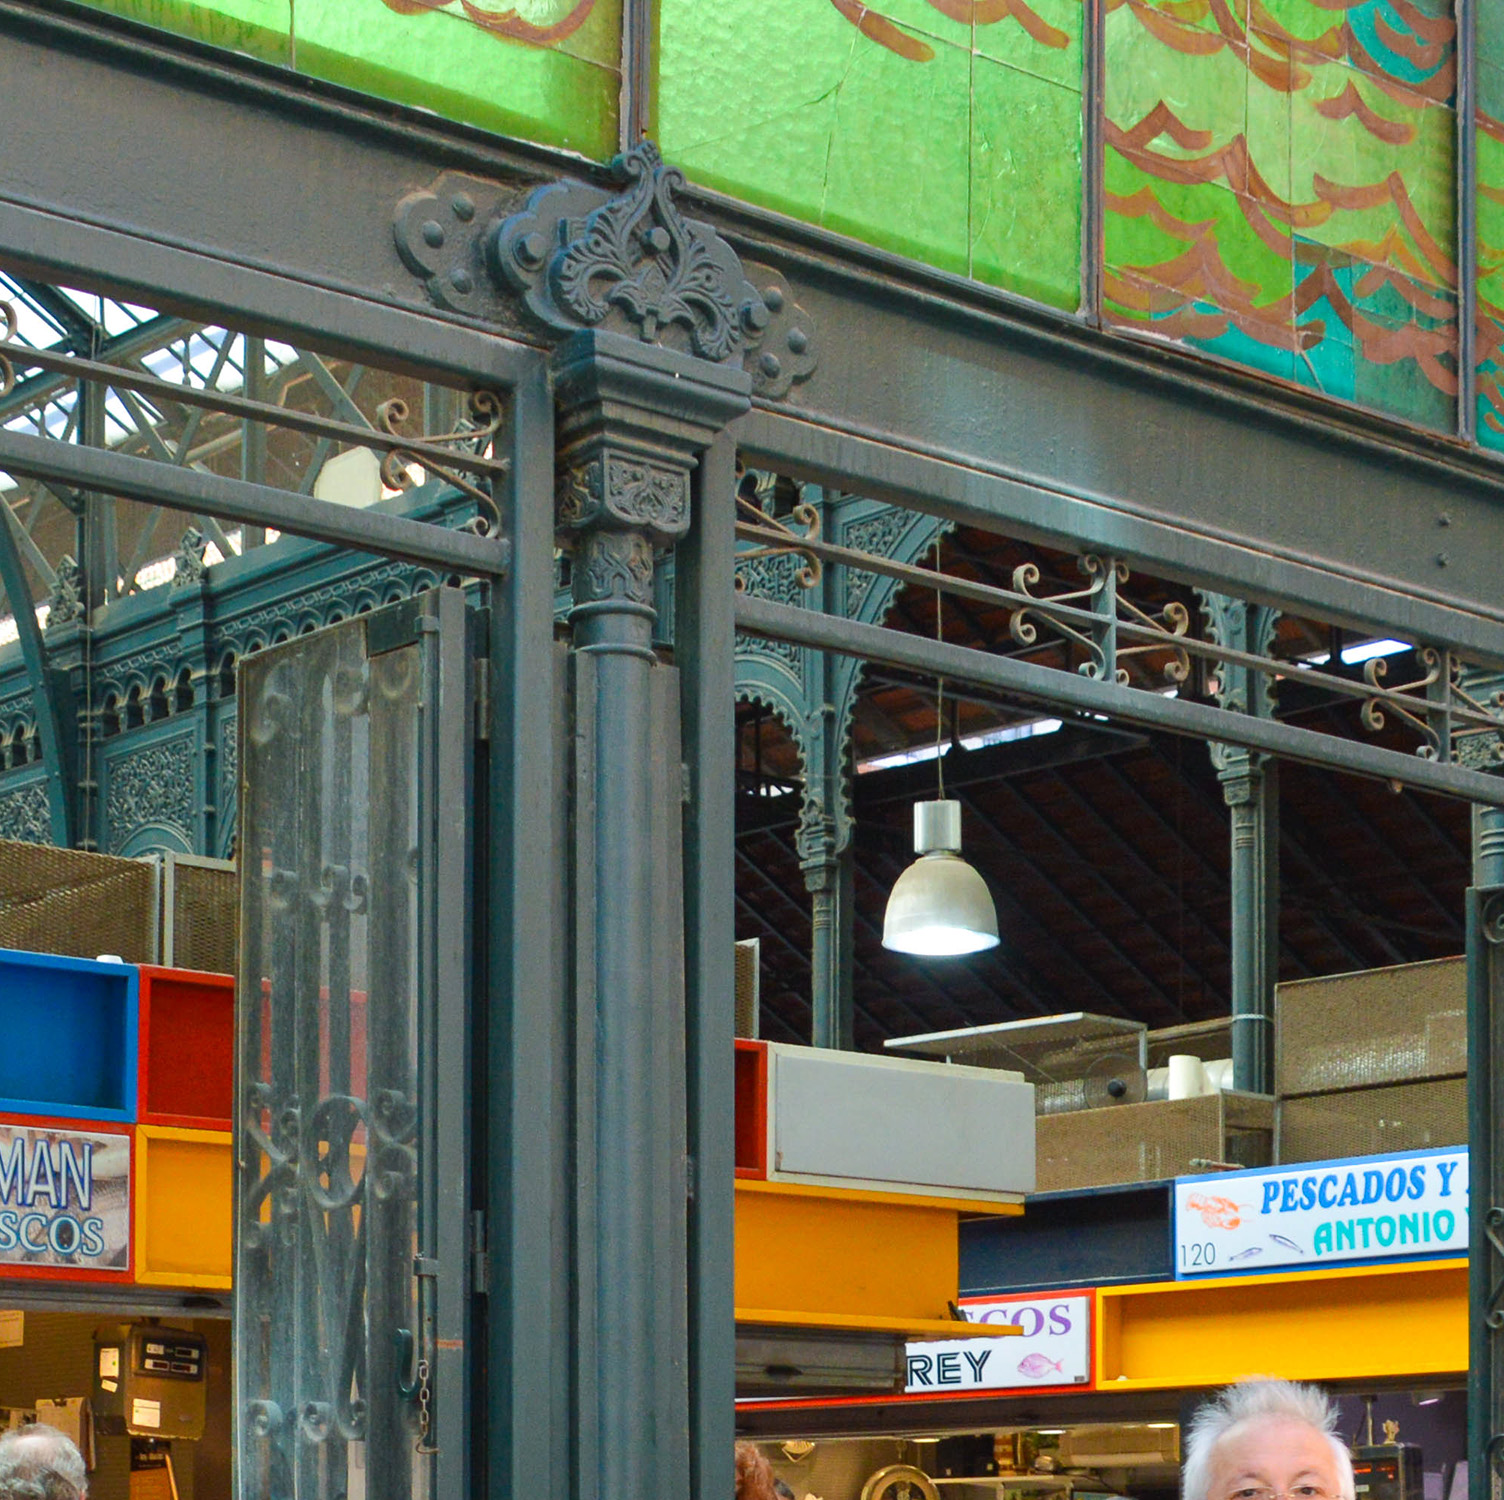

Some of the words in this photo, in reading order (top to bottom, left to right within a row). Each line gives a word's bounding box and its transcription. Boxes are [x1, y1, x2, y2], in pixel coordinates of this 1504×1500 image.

[1260, 1163, 1427, 1215] PESCADOS
[1437, 1160, 1458, 1198] Y
[1180, 1241, 1216, 1268] 120
[1313, 1209, 1455, 1257] ANTONIO
[907, 1349, 992, 1387] REY
